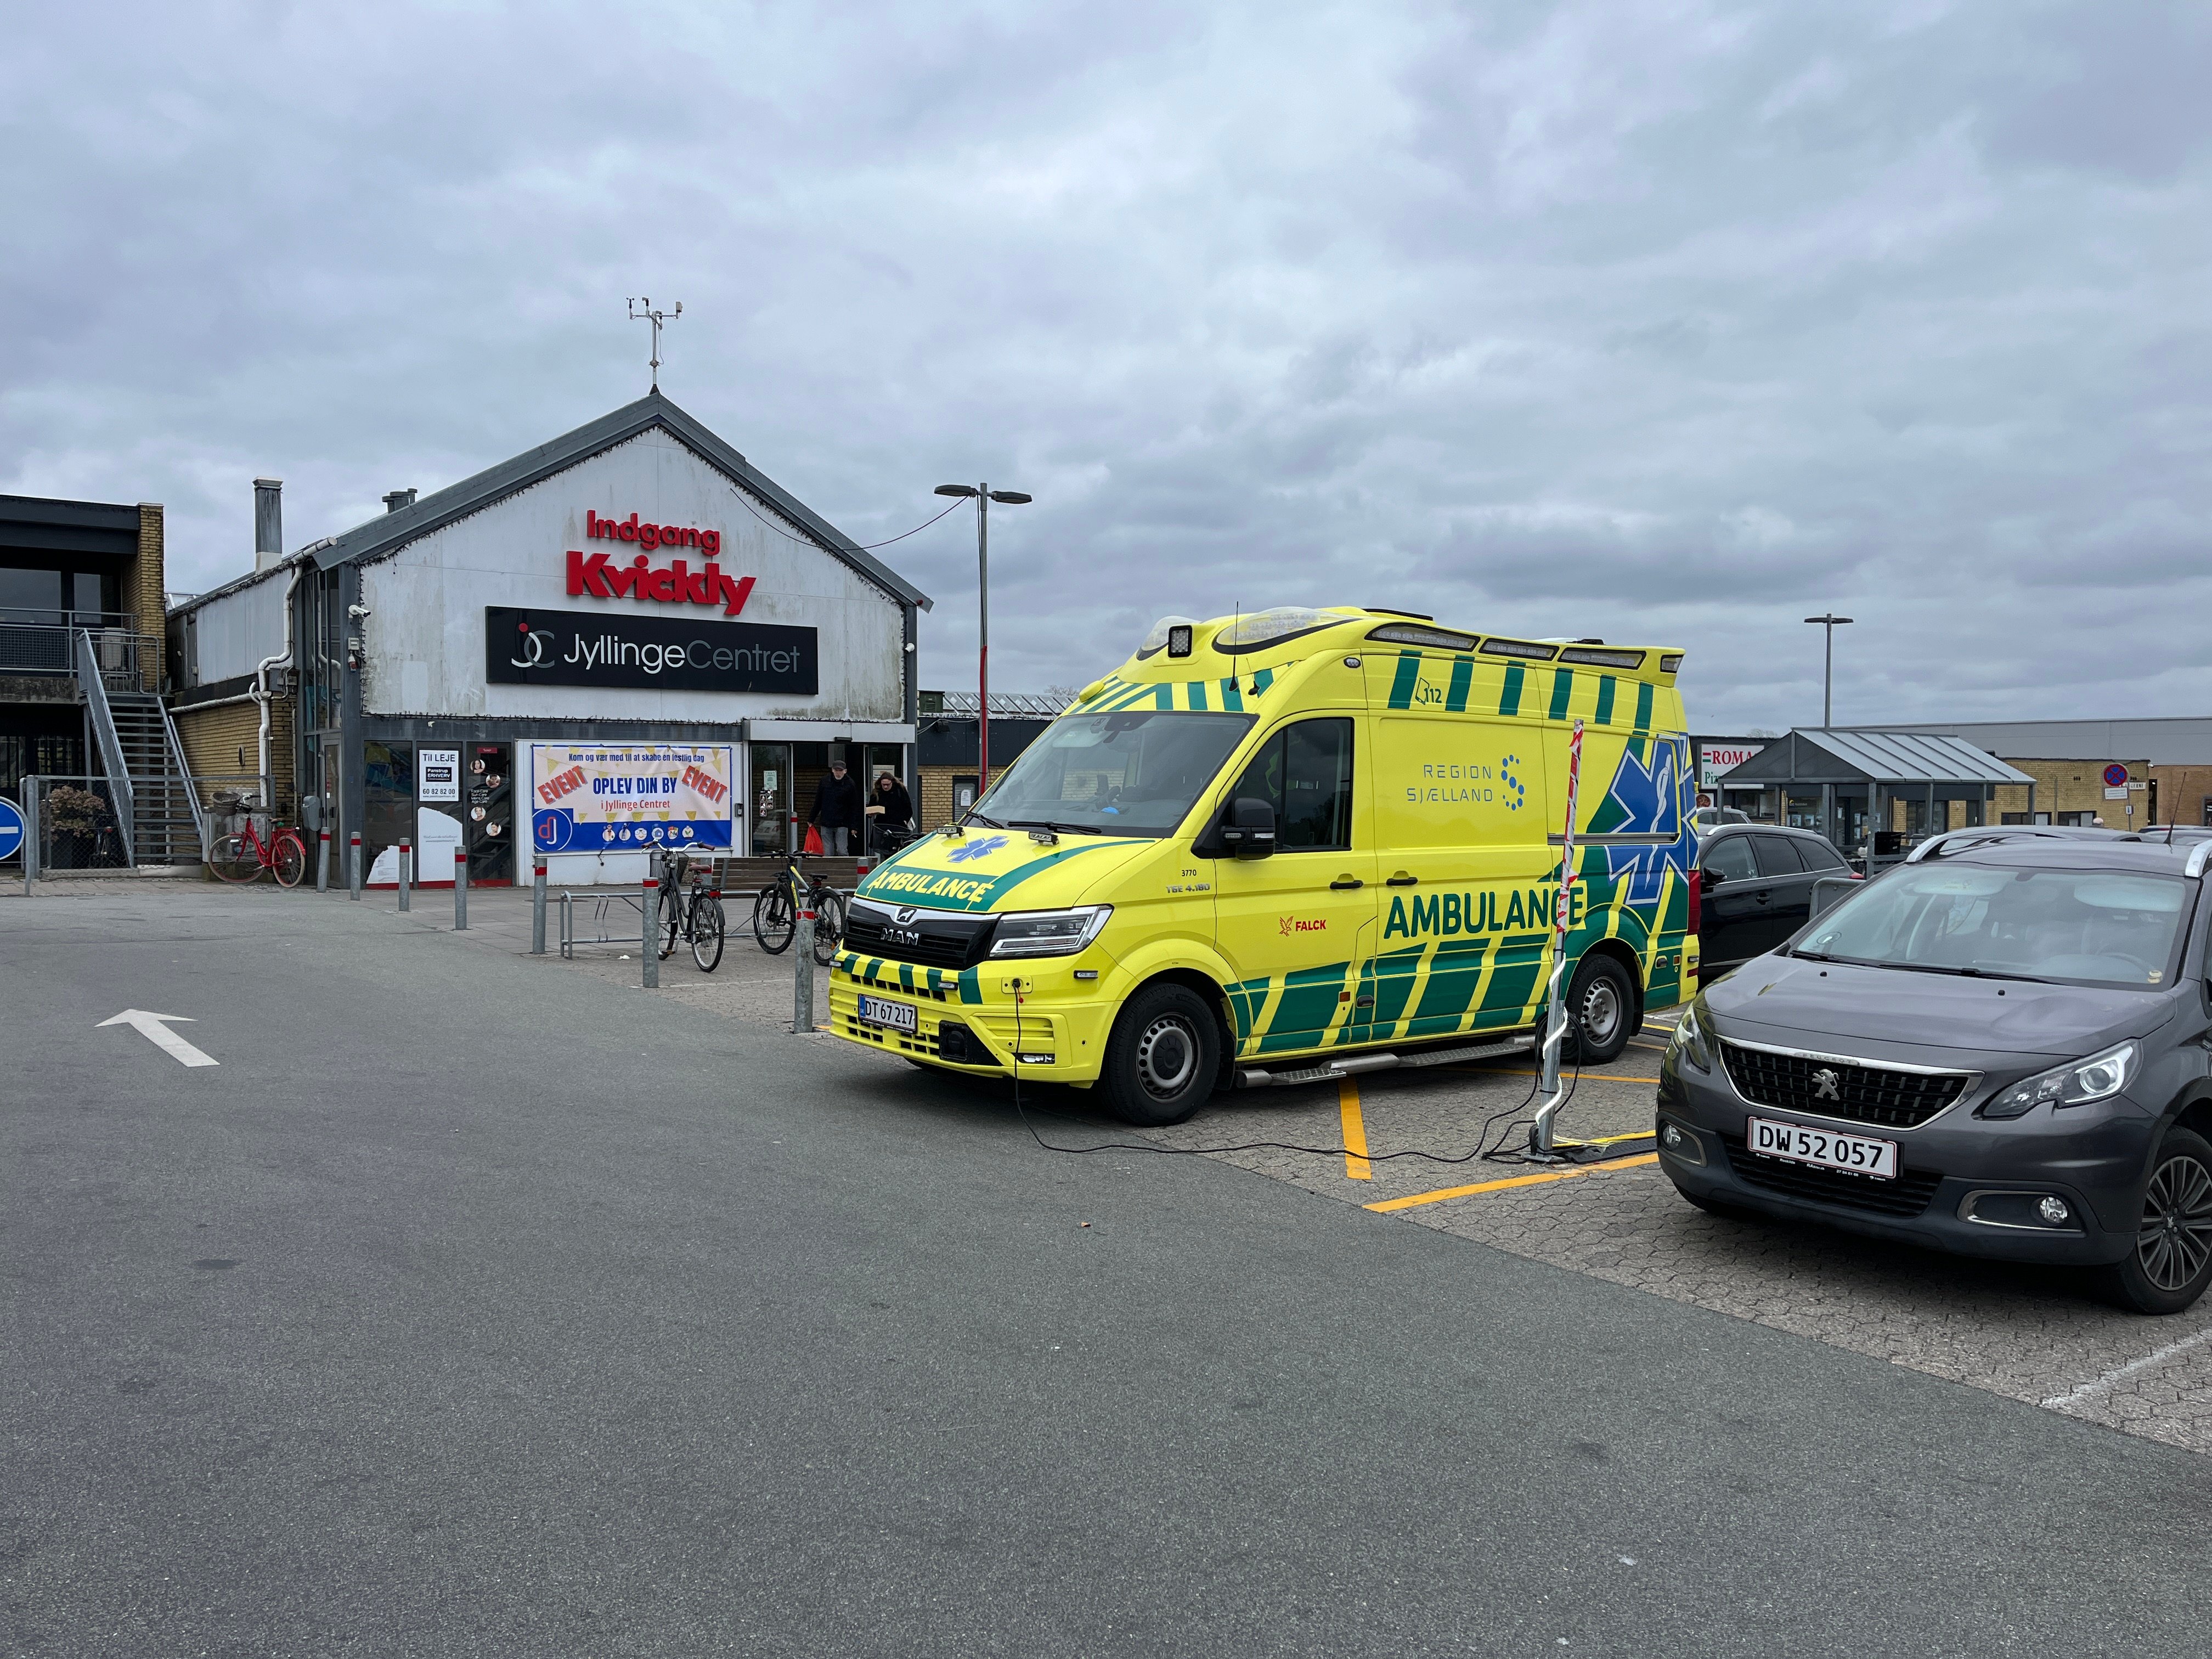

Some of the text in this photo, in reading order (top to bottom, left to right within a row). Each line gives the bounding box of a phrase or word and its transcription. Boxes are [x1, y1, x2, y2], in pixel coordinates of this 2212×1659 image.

[587, 510, 720, 556] Indgang
[566, 551, 757, 615] Kvickly
[564, 634, 800, 674] JyllingeCentret
[1424, 687, 1442, 704] 112
[568, 753, 584, 761] Kom
[642, 753, 662, 761] skabe
[693, 754, 704, 763] dag
[1424, 765, 1491, 779] REGION
[1705, 771, 1721, 784] Piz
[537, 765, 589, 805] EVENT
[593, 777, 677, 794] OPLEV DIN BY
[681, 765, 728, 804] EVENT
[1407, 788, 1493, 804] SJÆLLAND
[605, 800, 637, 811] Jyllinge
[640, 800, 670, 809] Centret
[867, 871, 995, 903] AMBULANCE
[1166, 883, 1210, 893] TGE 4.180
[1384, 887, 1584, 939] AMBULANCE
[1295, 919, 1327, 932] FALCK
[880, 927, 919, 946] MAN
[865, 1000, 913, 1025] DT 67 217
[1803, 1053, 1853, 1064] PEUGEOT
[1759, 1125, 1883, 1168] DW 52 057
